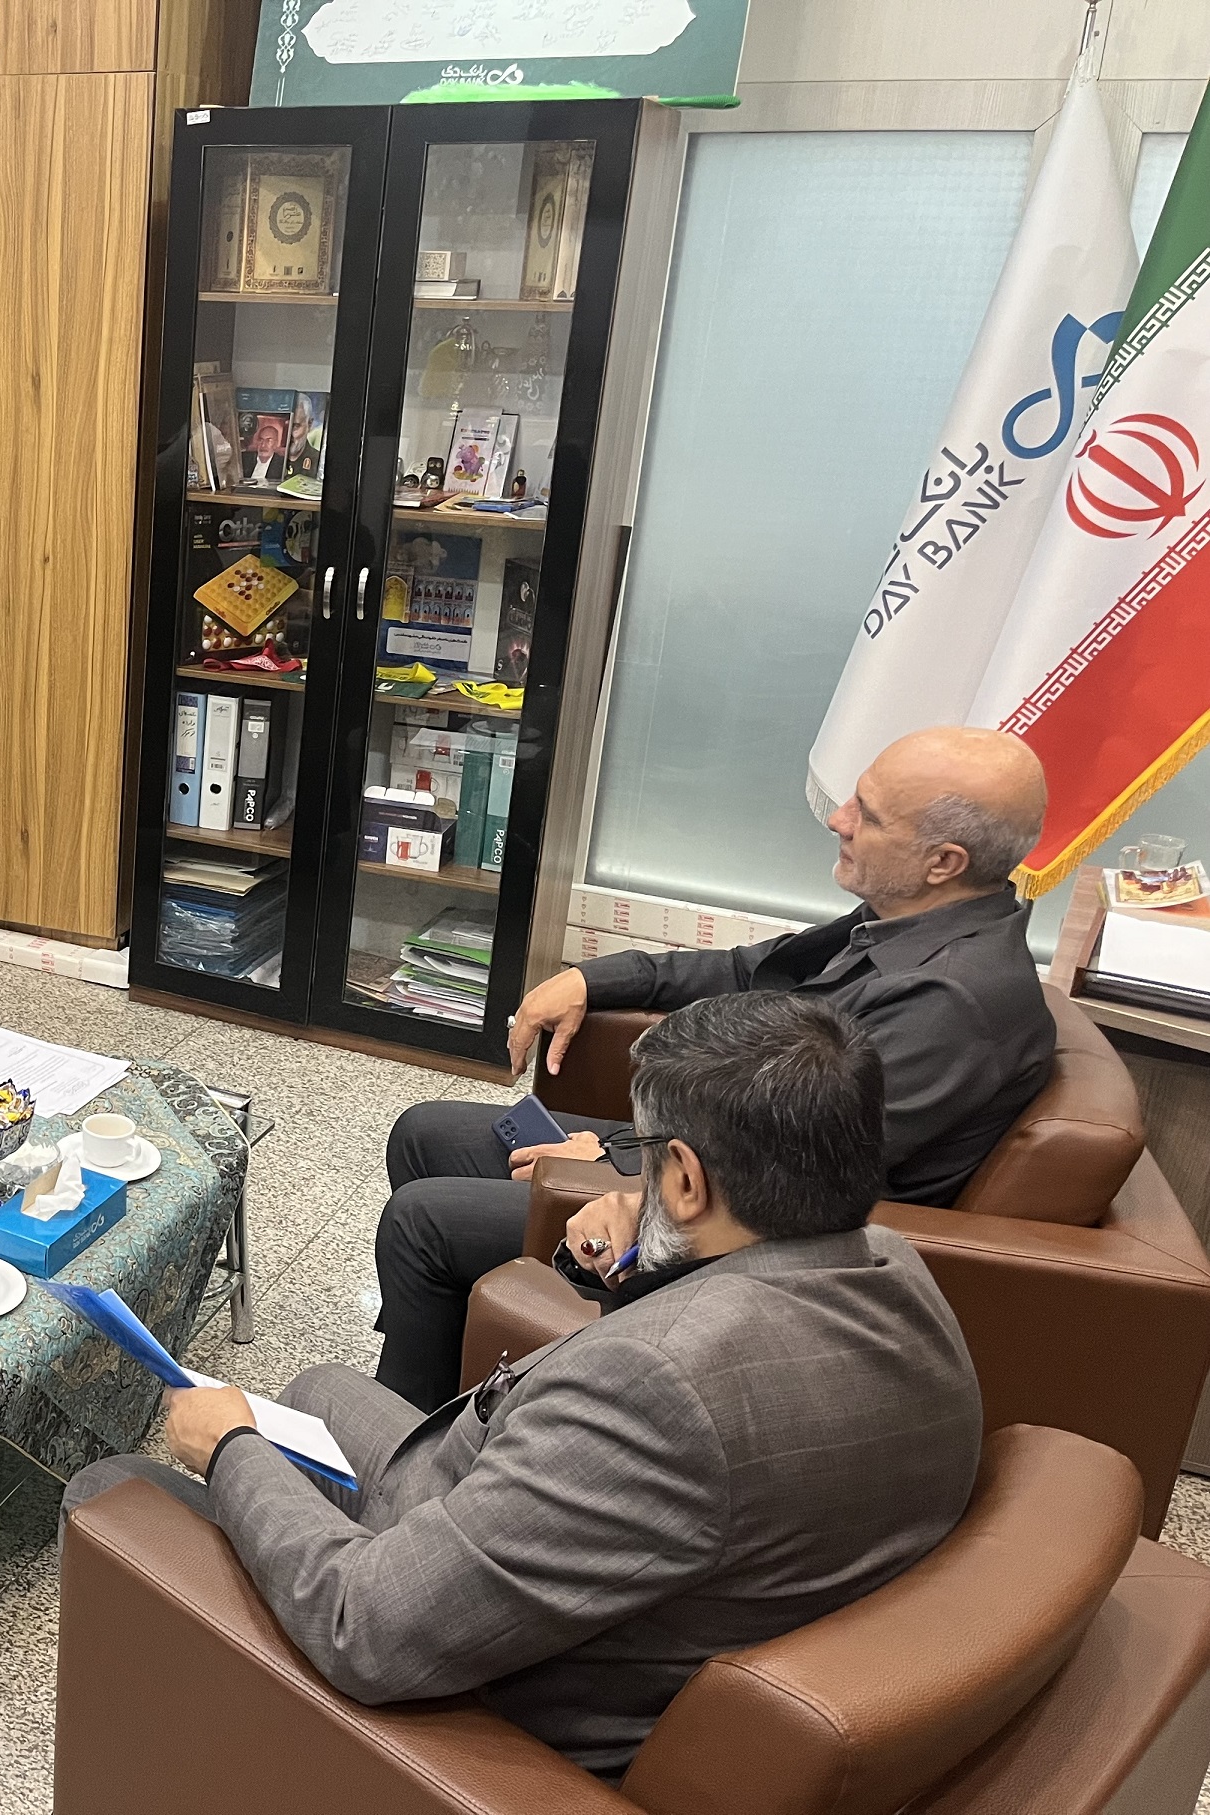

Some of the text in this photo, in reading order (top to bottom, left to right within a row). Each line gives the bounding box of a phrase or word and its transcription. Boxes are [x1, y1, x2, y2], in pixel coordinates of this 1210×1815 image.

[863, 460, 1027, 640] DAY BANK
[245, 789, 257, 822] PAPCO
[493, 829, 505, 864] PAPCO
